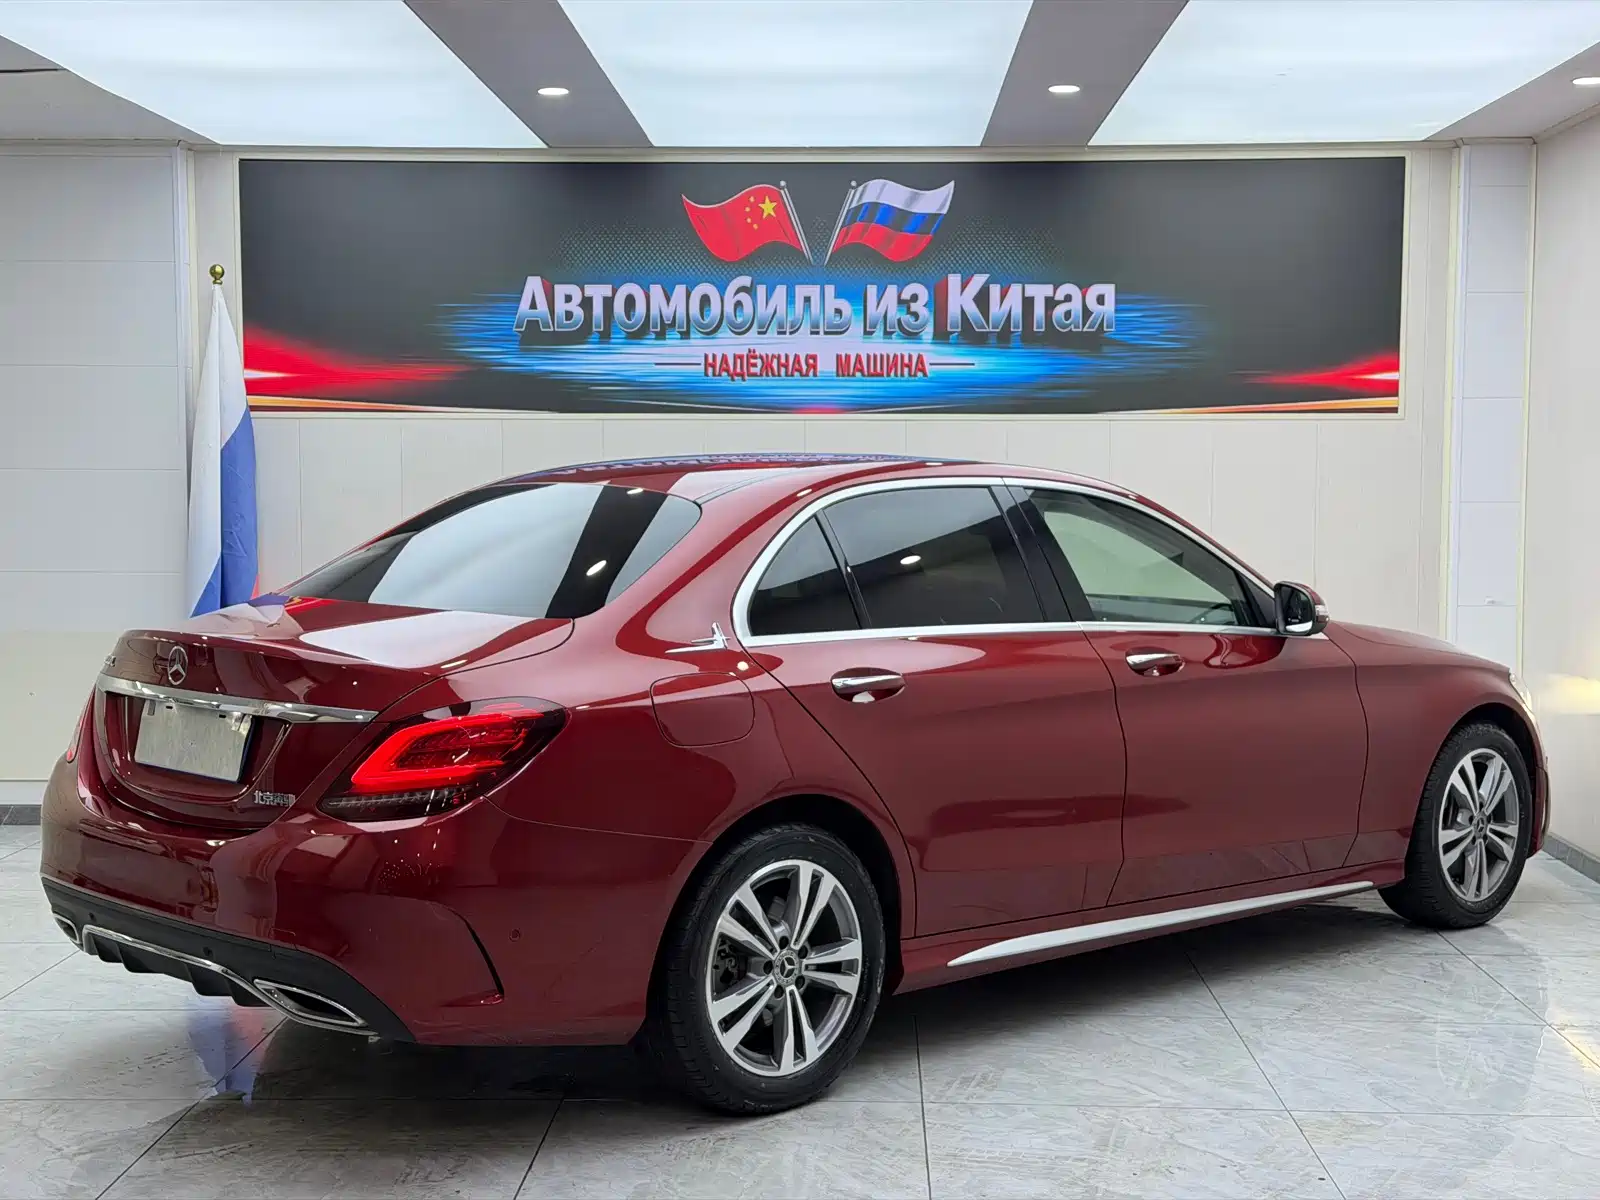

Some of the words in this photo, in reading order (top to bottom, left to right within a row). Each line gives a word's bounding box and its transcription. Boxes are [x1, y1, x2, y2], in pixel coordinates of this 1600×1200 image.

[864, 283, 930, 336] из
[943, 273, 1117, 334] Китая
[704, 348, 818, 381] НАДЁЖНАЯ
[836, 352, 929, 378] МАШИНА
